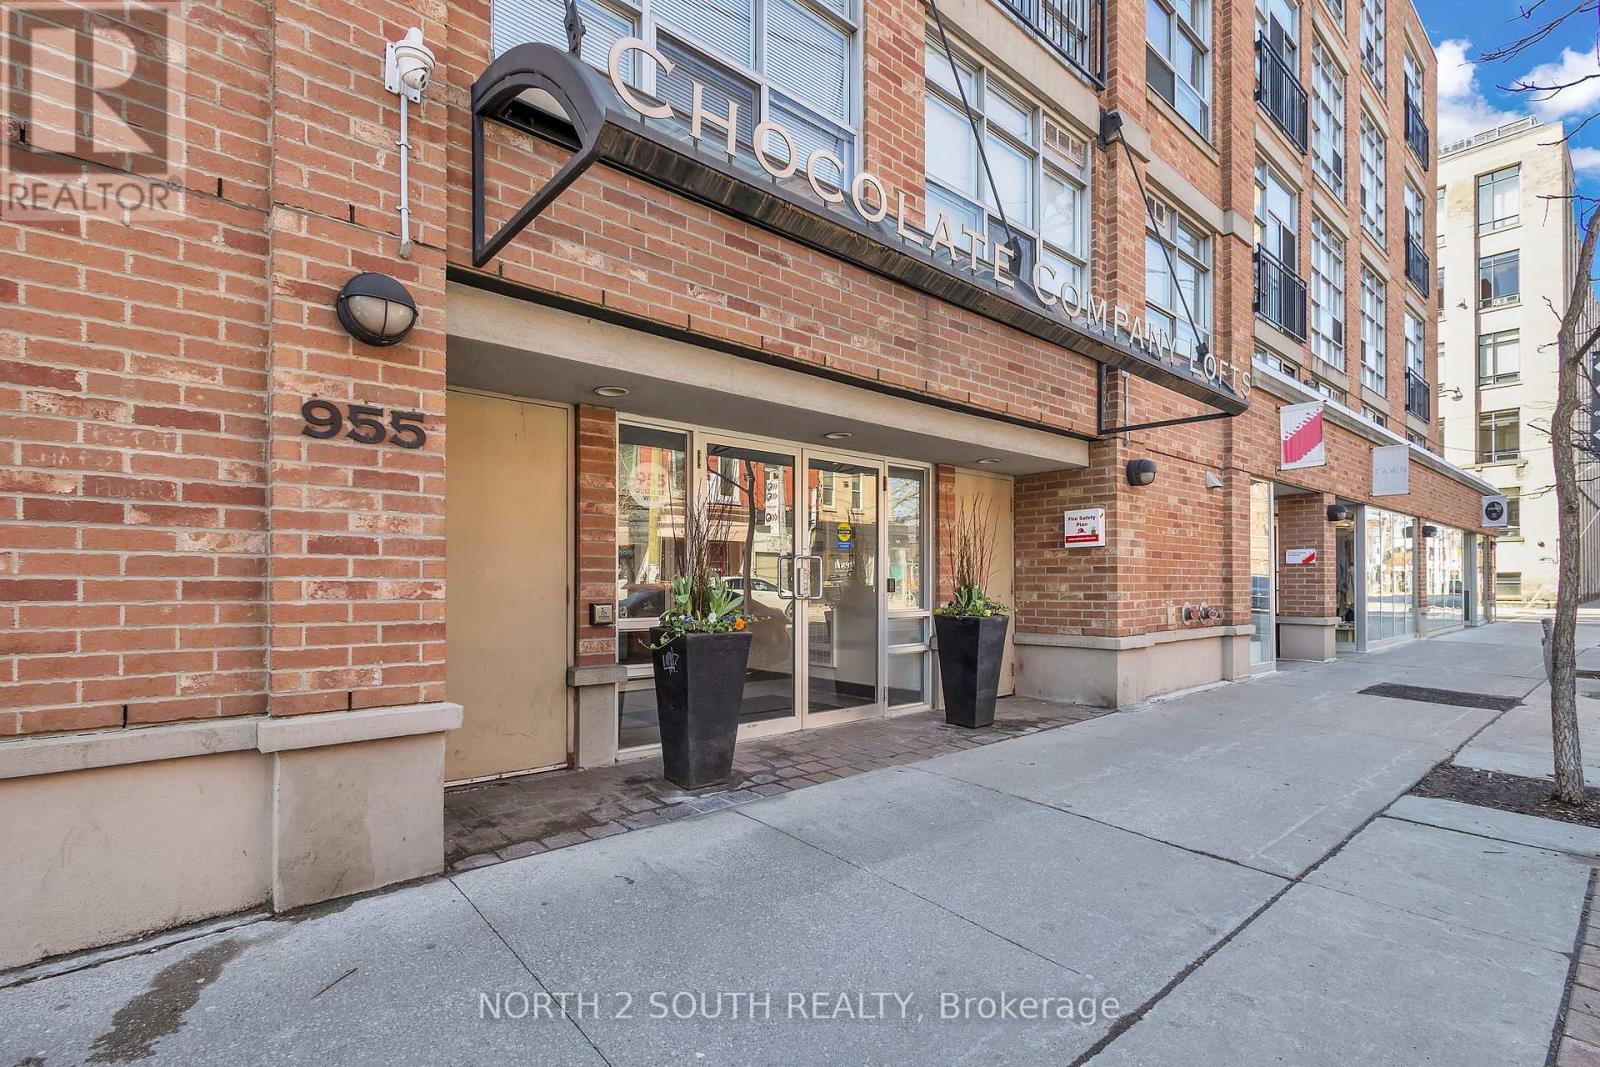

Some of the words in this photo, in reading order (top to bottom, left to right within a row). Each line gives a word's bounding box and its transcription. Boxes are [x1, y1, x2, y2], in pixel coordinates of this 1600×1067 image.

[607, 37, 1015, 290] CHOCOLATE
[1033, 260, 1177, 366] COMPANY
[1189, 337, 1251, 399] LOFTS
[302, 399, 427, 450] 955
